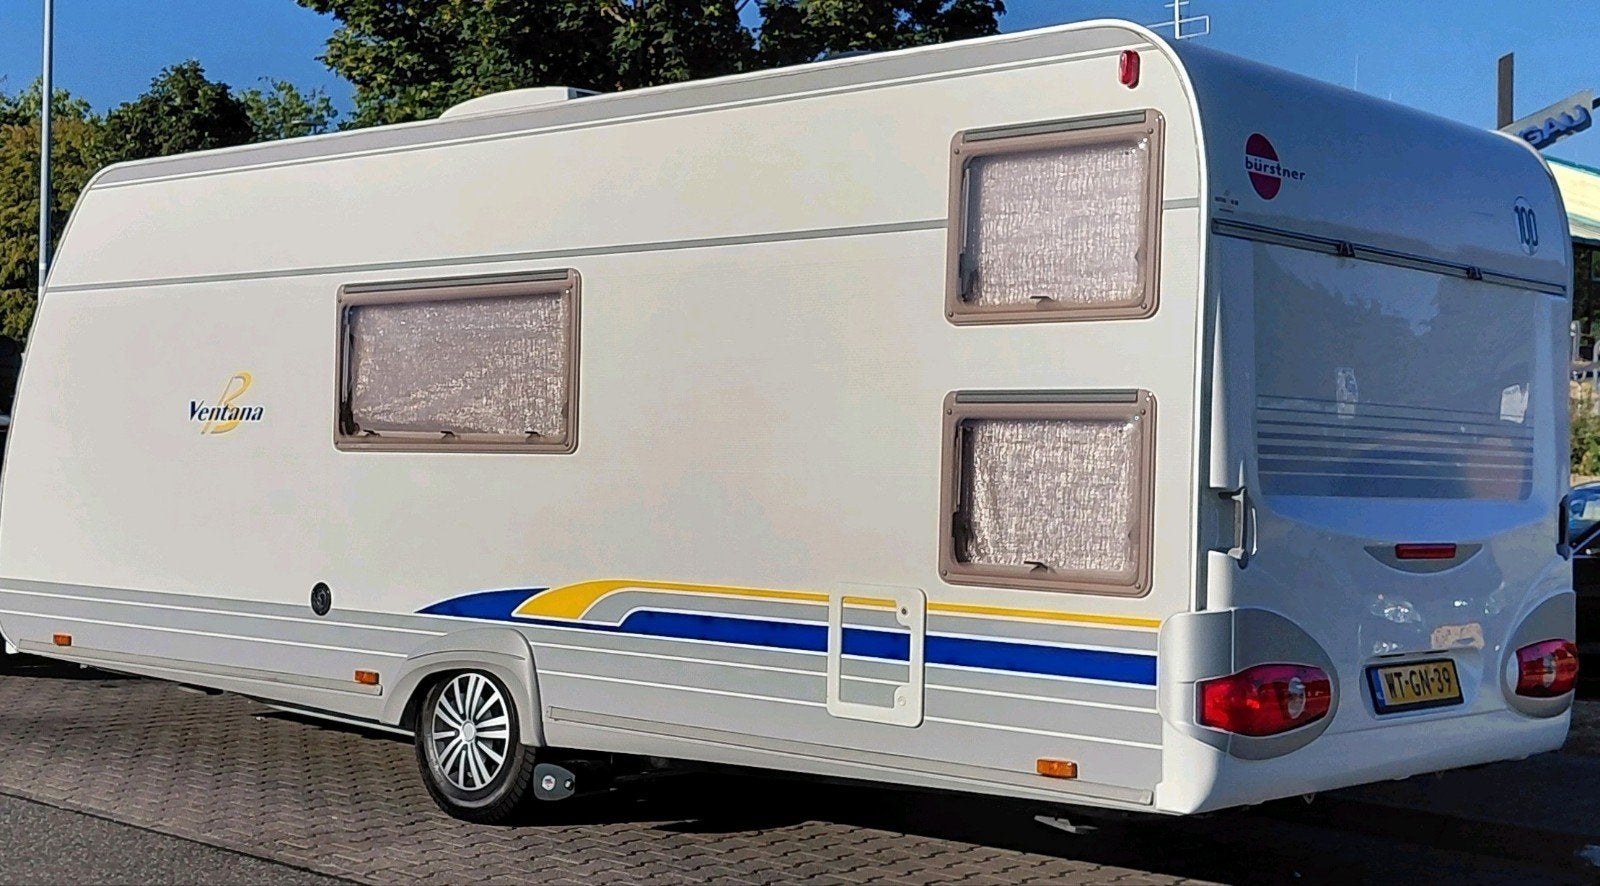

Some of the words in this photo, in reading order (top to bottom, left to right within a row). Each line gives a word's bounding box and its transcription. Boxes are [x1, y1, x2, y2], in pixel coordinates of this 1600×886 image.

[1245, 156, 1306, 180] bürstner
[1514, 205, 1538, 246] 100
[189, 400, 264, 421] Ventana
[1384, 667, 1452, 699] WT-GN-39
